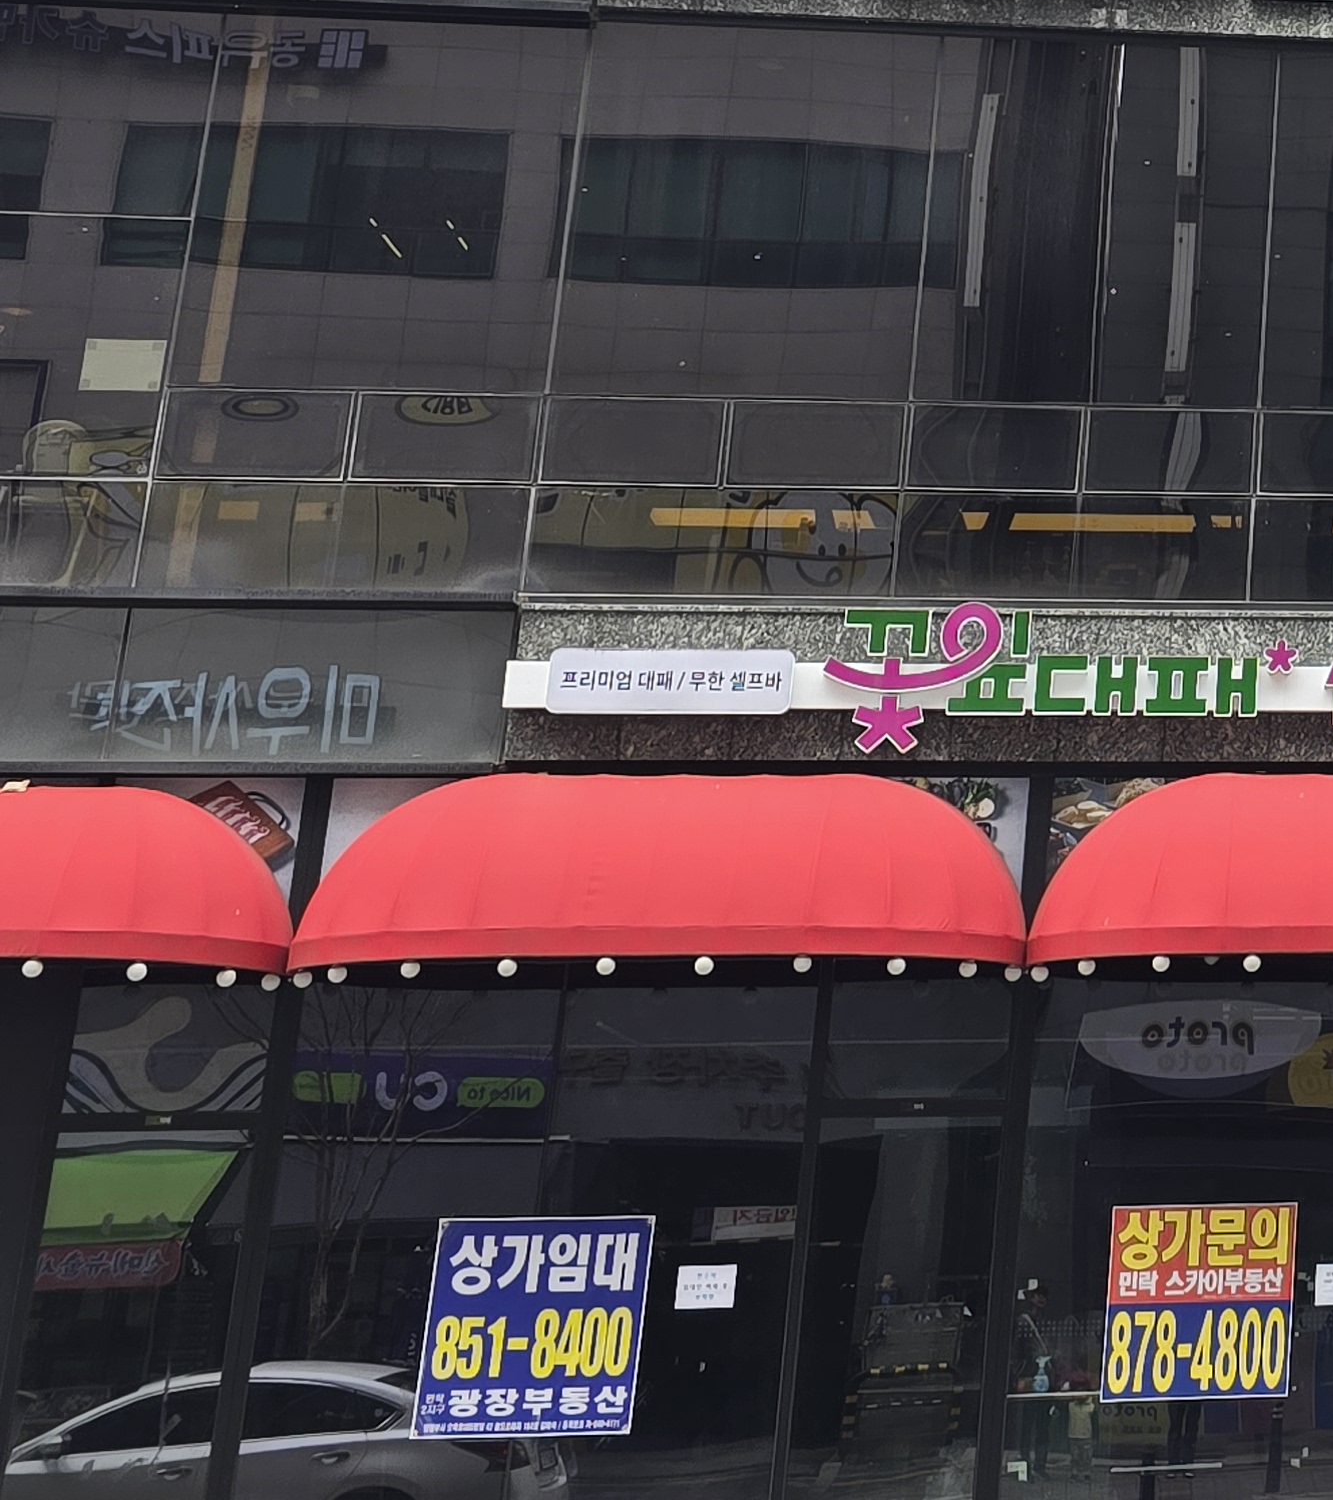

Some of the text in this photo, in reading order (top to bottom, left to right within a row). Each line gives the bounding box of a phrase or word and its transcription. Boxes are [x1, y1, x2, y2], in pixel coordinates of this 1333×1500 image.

[561, 669, 783, 694] 프리미엄 대패 무한 셀프바
[823, 601, 1259, 755] 꽃잎대패
[449, 1232, 641, 1296] 상가임대
[1117, 1206, 1292, 1270] 상가문의
[1118, 1267, 1284, 1297] 민락 스카이부동산
[430, 1306, 634, 1381] 851-8400
[1106, 1305, 1286, 1395] 878-4800
[447, 1385, 629, 1419] 광장부동산
